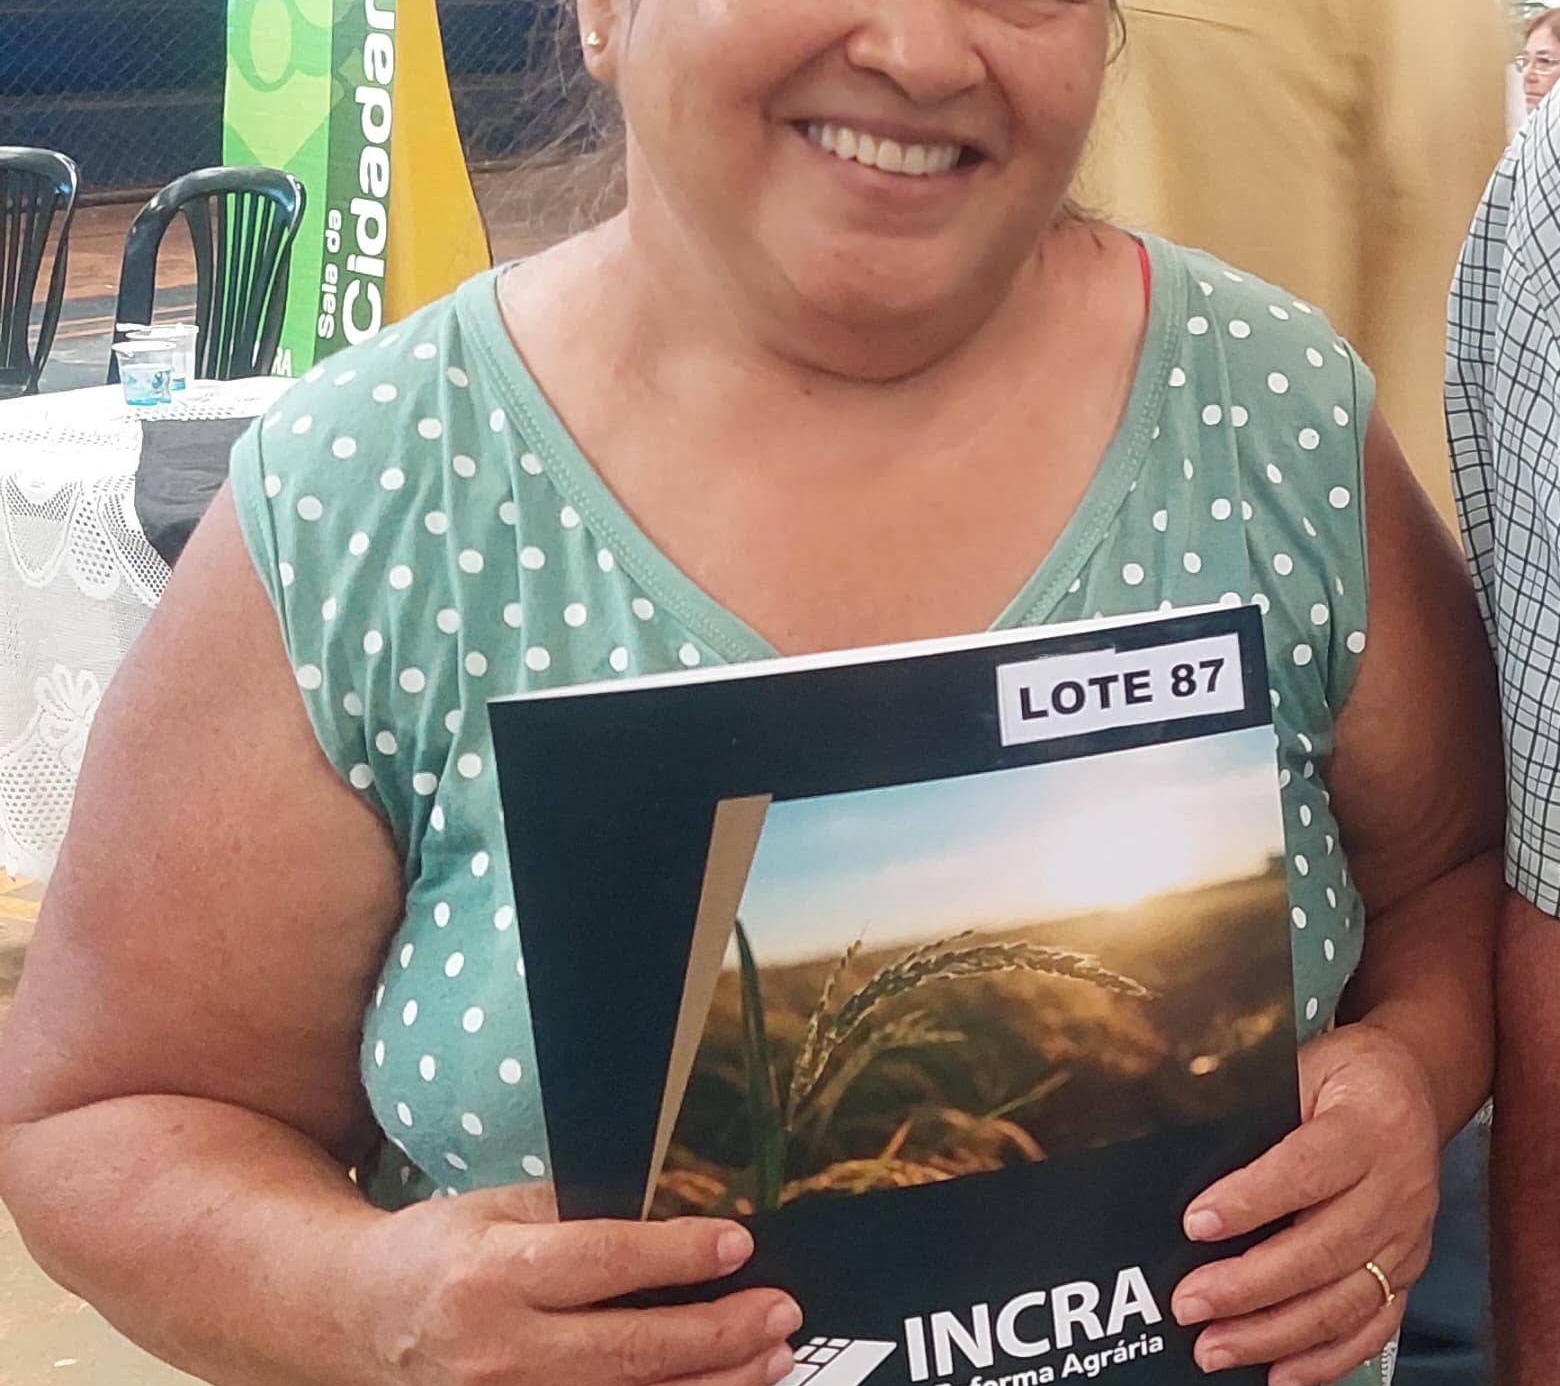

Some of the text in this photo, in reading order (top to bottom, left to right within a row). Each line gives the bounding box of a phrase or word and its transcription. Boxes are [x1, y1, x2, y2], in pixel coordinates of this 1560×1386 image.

[318, 209, 342, 339] Sala da
[1019, 658, 1225, 720] LOTE 87
[904, 1266, 1162, 1382] INCRA
[1061, 1332, 1165, 1381] Agrária
